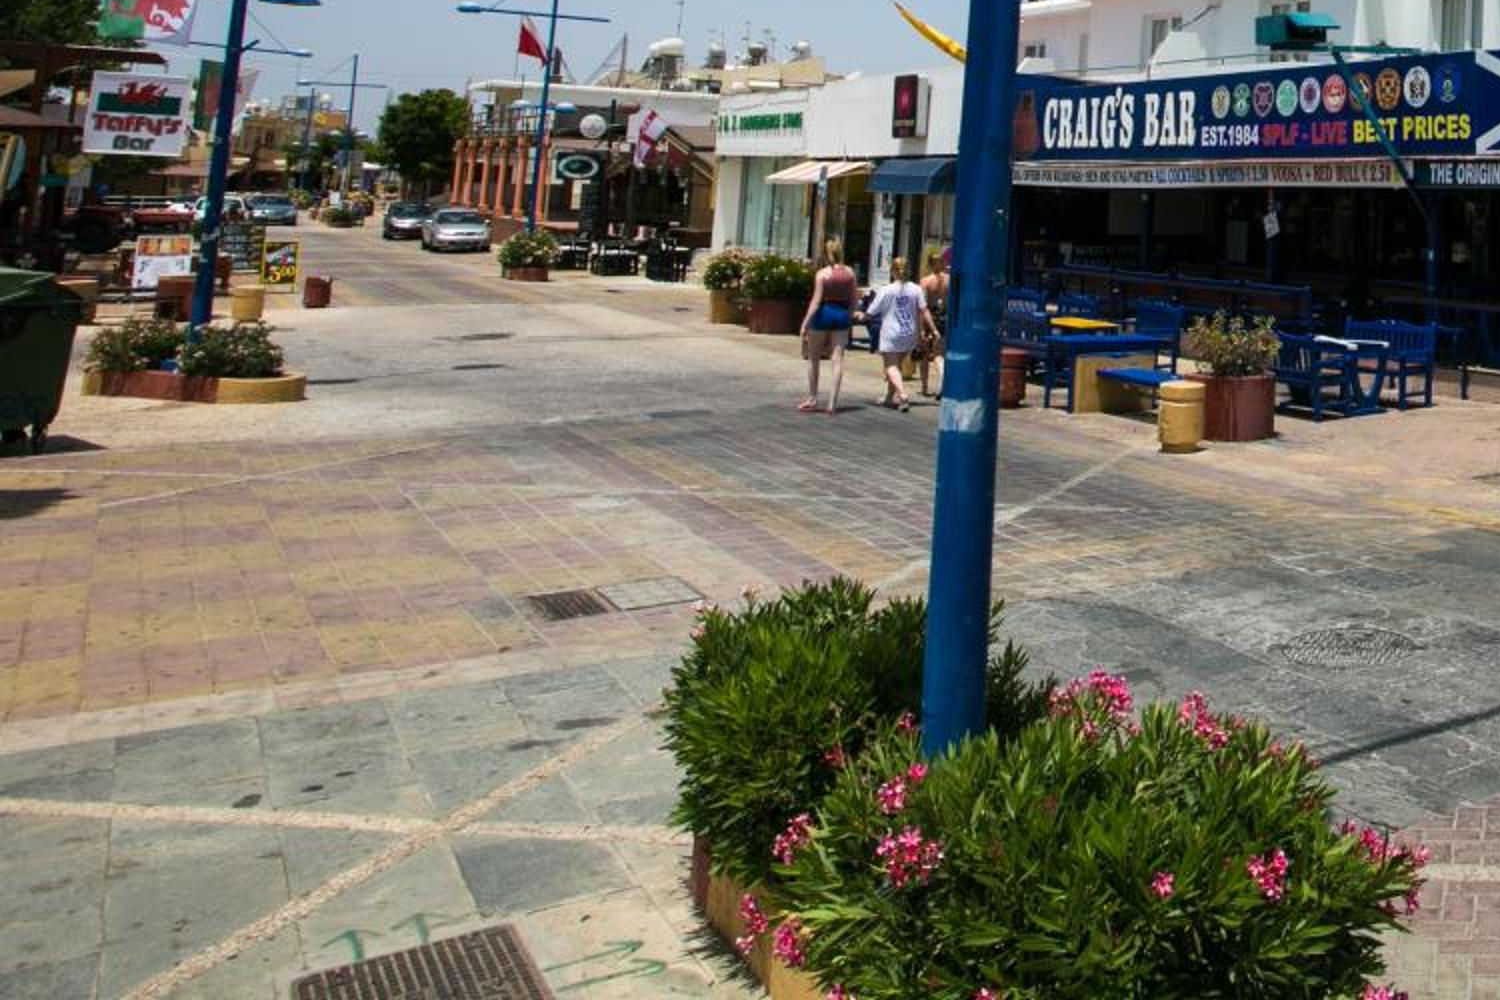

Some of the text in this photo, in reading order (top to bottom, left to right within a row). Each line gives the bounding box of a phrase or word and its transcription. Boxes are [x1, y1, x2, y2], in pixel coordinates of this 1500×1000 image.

[93, 113, 182, 136] Taffy's
[1043, 87, 1197, 149] CRAIG'S BAR
[1201, 123, 1259, 147] EST.1984
[1312, 121, 1347, 145] LIVE
[1403, 114, 1471, 141] PRICES
[113, 135, 155, 150] Bar
[1430, 162, 1453, 184] THE
